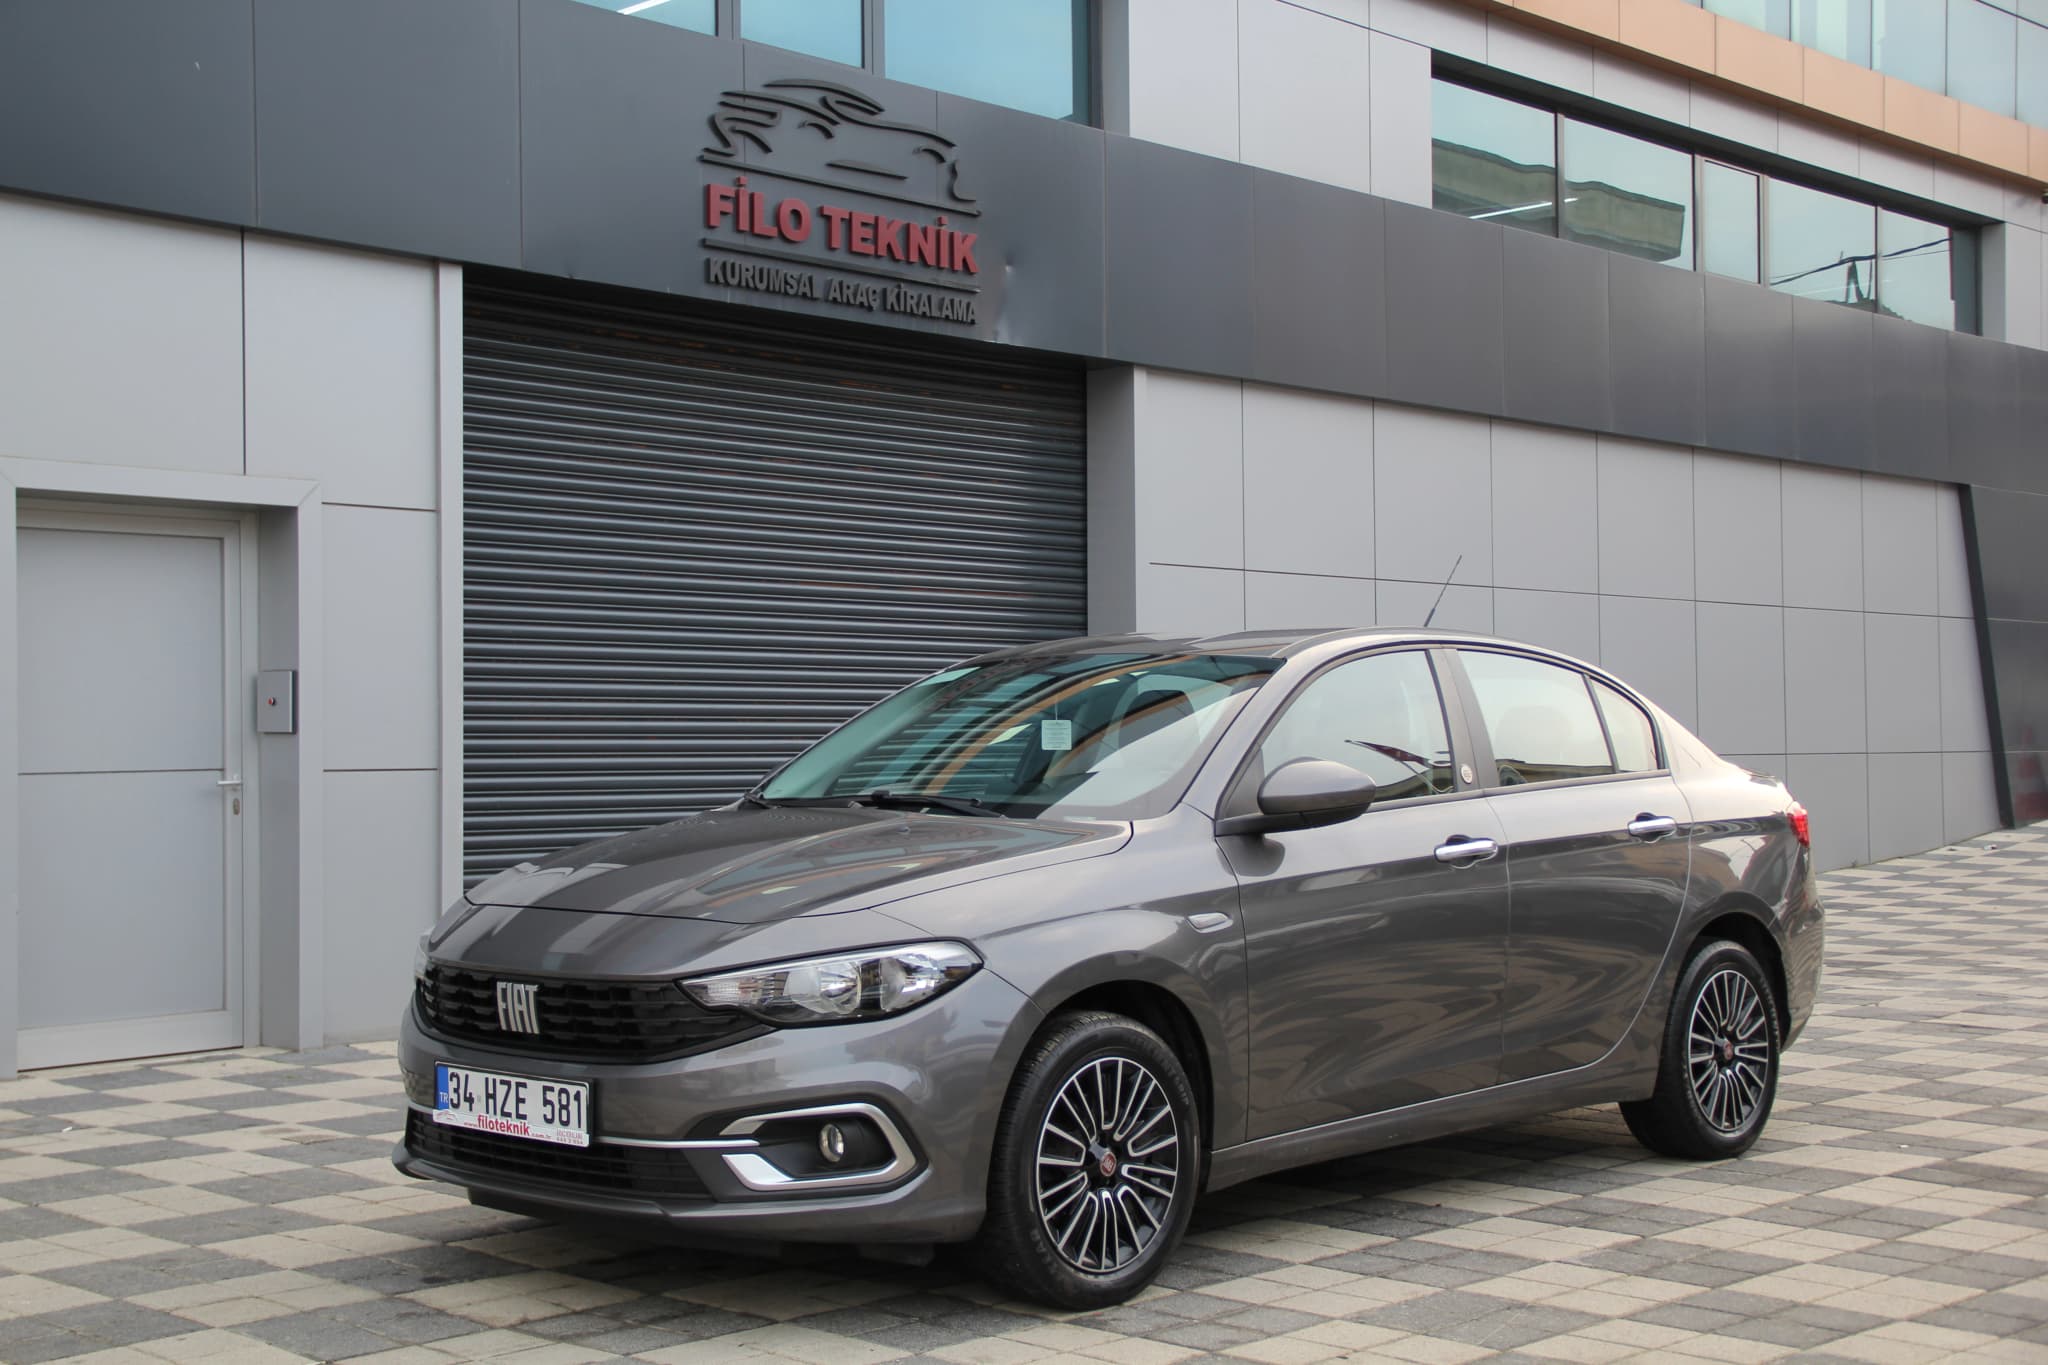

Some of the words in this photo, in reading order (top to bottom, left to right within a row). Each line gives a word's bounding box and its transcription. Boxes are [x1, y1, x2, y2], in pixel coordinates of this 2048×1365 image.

[705, 175, 812, 242] FİLO
[819, 204, 980, 274] TEKNİK
[705, 257, 821, 301] KURUMSAL
[826, 276, 881, 311] ARAÇ
[885, 283, 977, 325] KİRALAMA
[496, 981, 540, 1035] FIAT
[439, 1091, 449, 1104] TR
[449, 1071, 475, 1112] 34
[485, 1076, 528, 1121] HZE
[542, 1084, 582, 1129] 581
